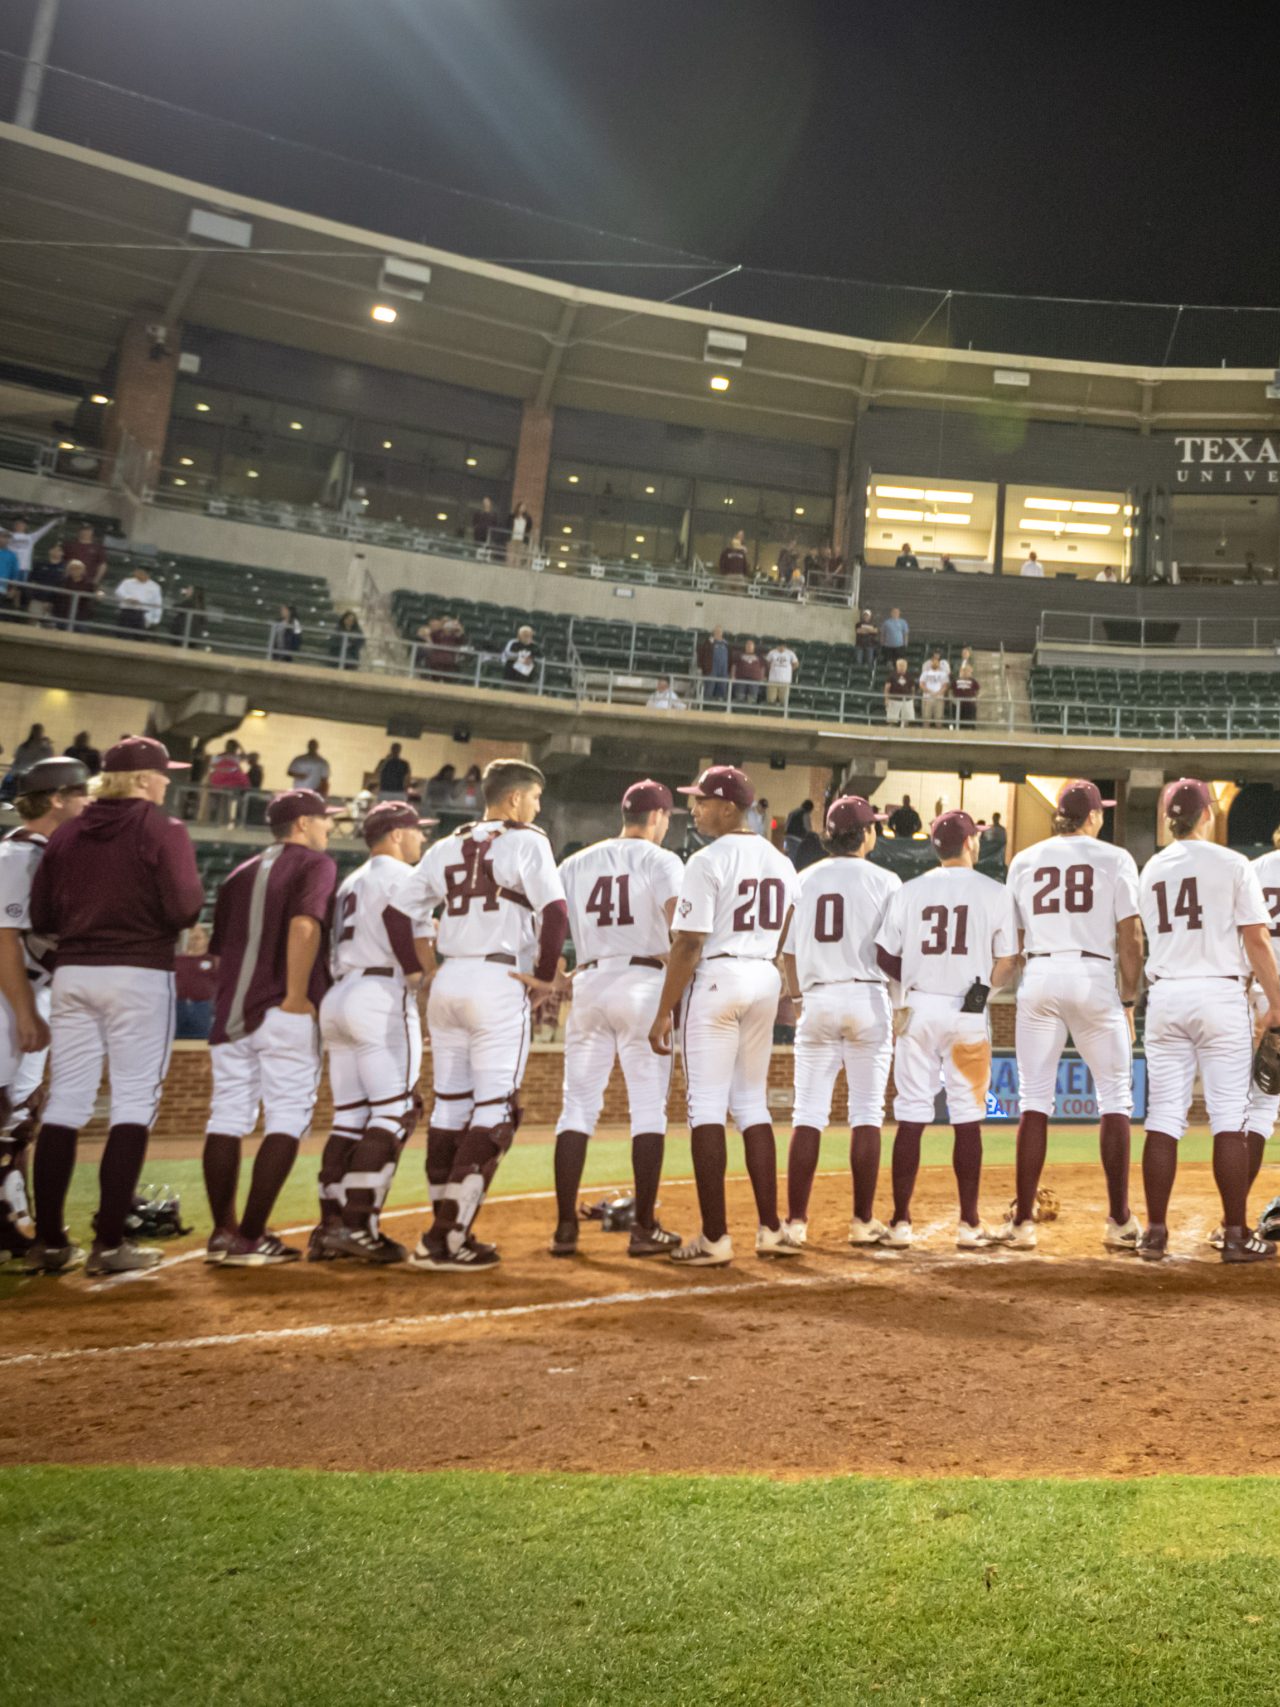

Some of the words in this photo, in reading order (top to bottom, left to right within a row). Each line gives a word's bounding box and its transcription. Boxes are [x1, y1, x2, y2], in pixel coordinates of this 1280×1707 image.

[585, 874, 635, 927] 41
[732, 878, 785, 932] 20
[1032, 864, 1094, 915] 28
[1151, 877, 1203, 934] 14
[814, 893, 844, 943] 0
[921, 905, 969, 955] 31
